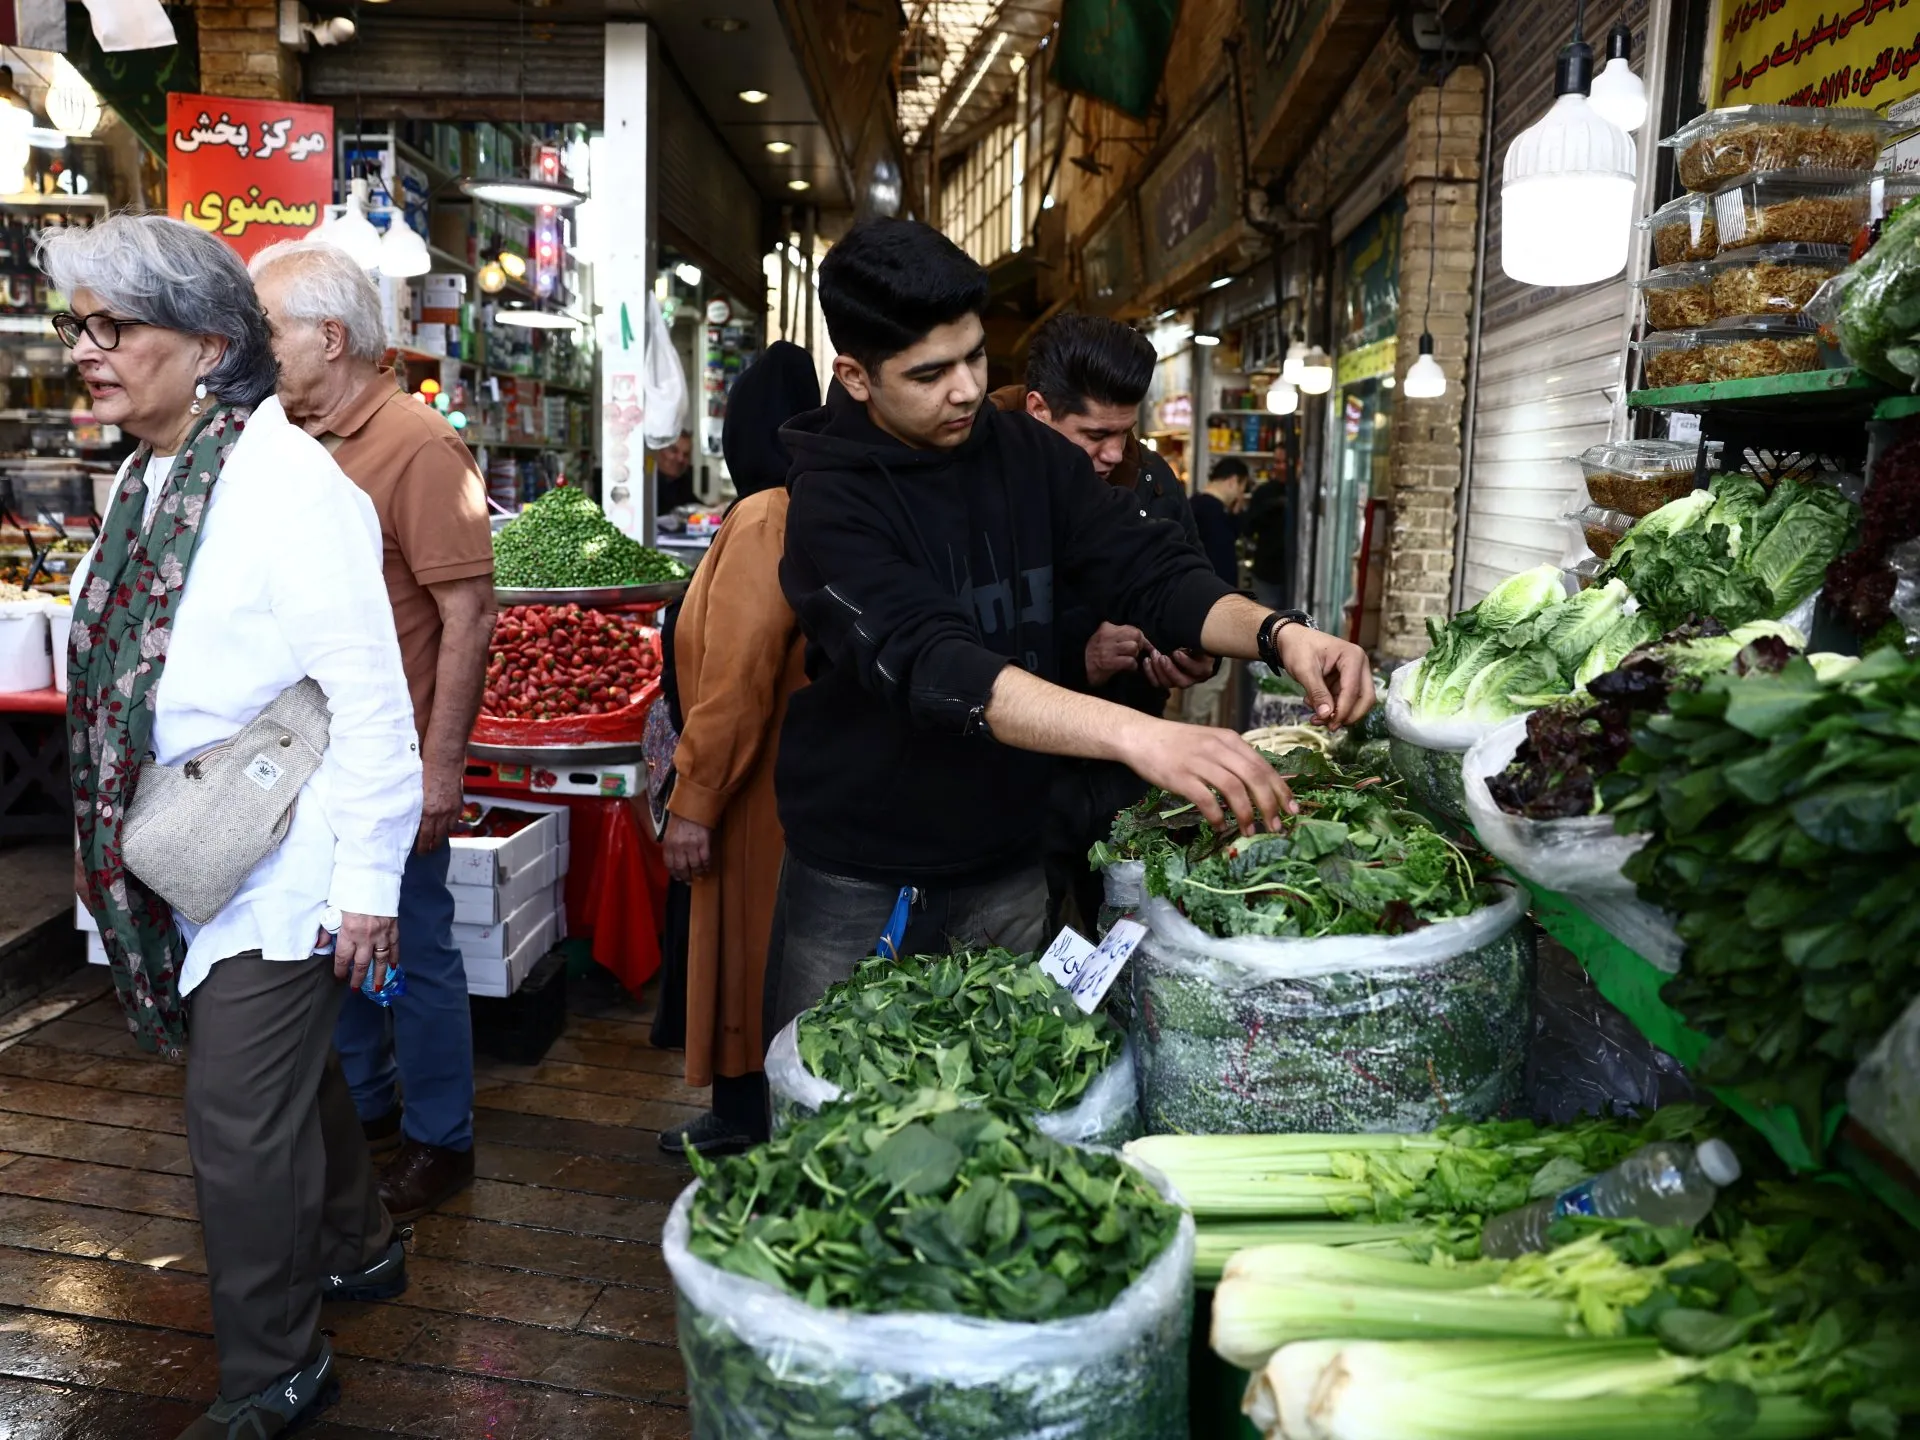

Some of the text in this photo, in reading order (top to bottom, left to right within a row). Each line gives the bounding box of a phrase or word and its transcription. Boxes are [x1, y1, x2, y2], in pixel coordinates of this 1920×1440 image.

[174, 111, 326, 161] مرکز پخش
[183, 185, 317, 236] سمنوی
